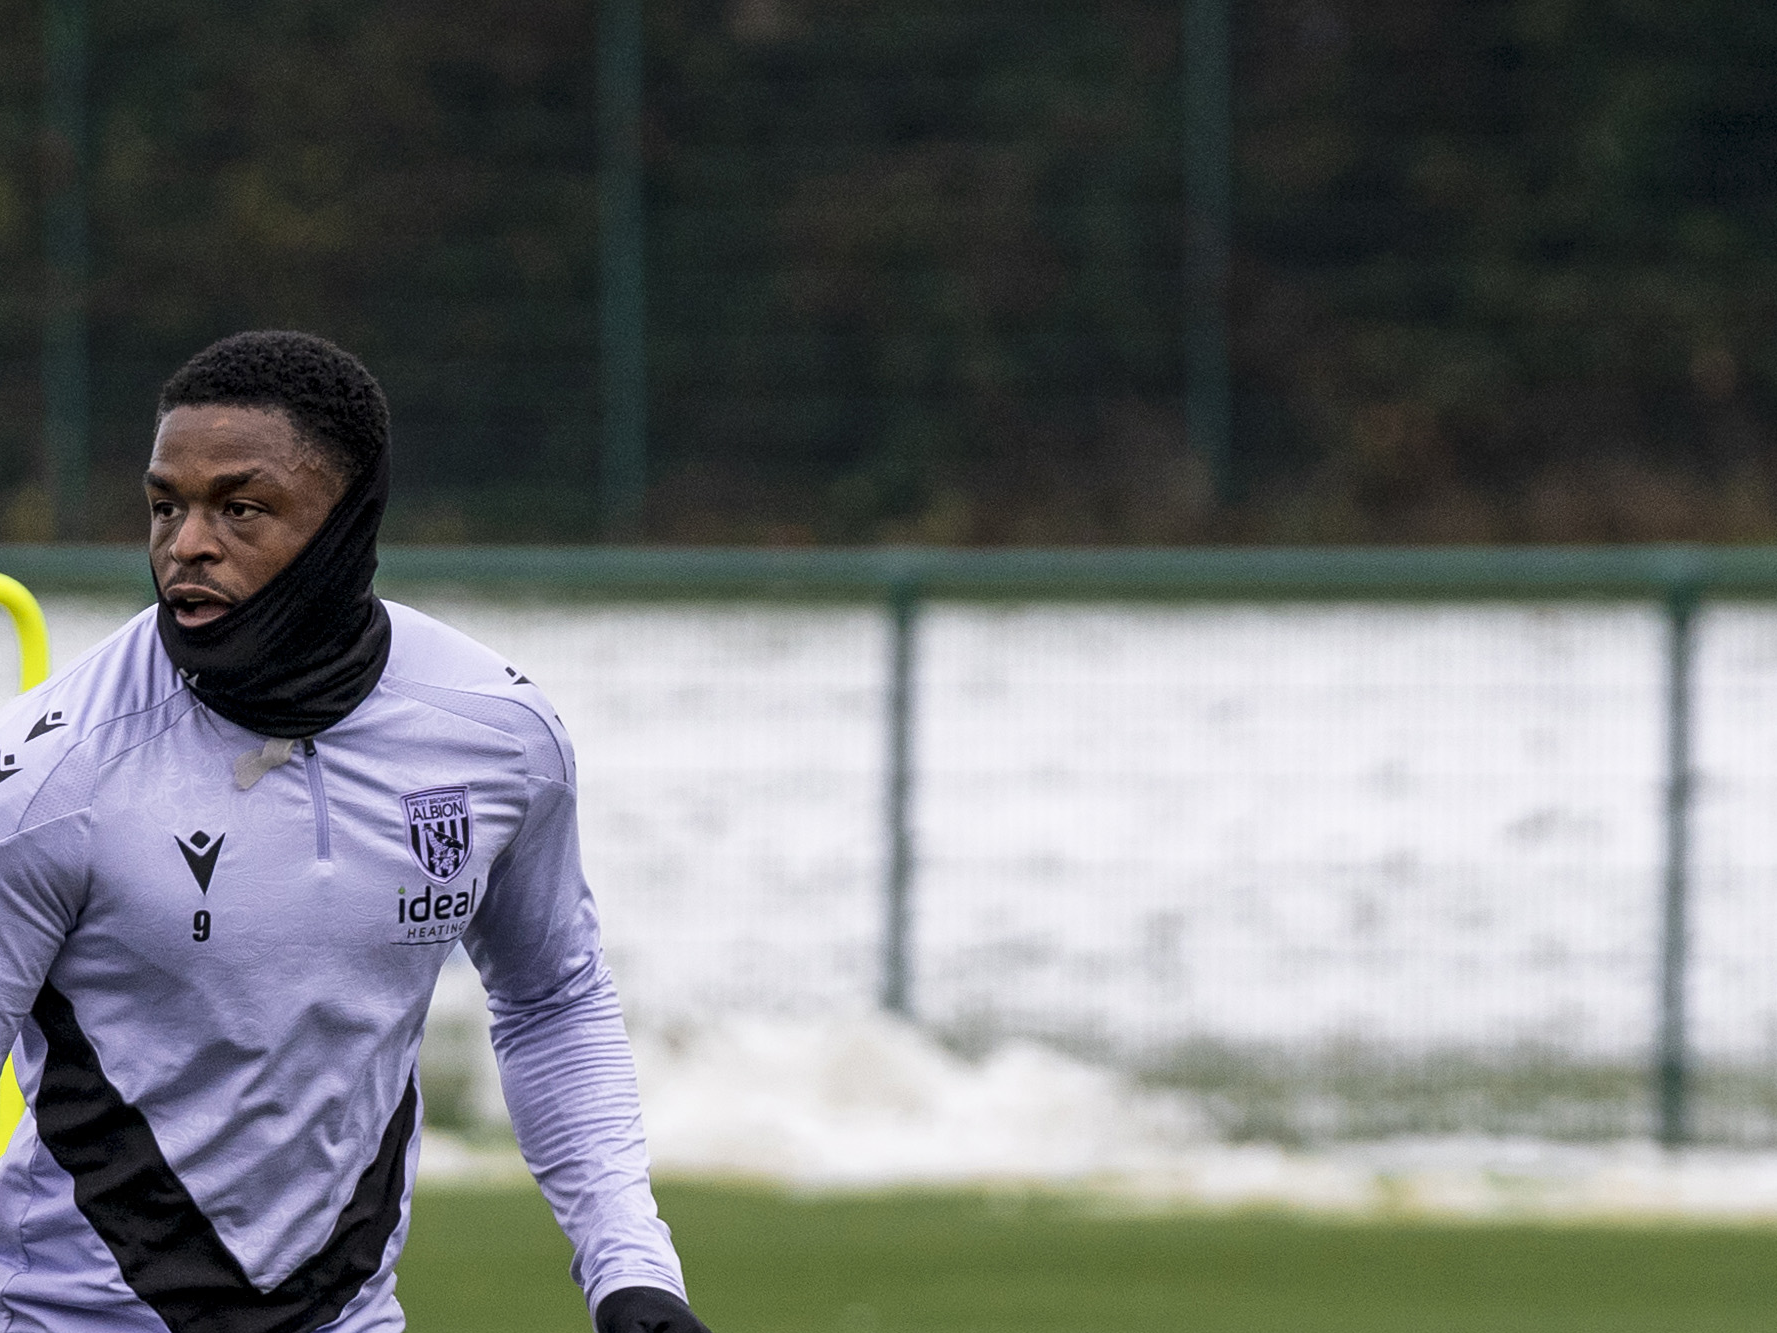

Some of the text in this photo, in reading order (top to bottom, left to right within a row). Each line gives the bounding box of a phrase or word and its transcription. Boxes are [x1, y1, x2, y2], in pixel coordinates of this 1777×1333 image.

[412, 800, 464, 822] ALBION
[398, 878, 477, 924] ideal
[192, 909, 211, 943] 9
